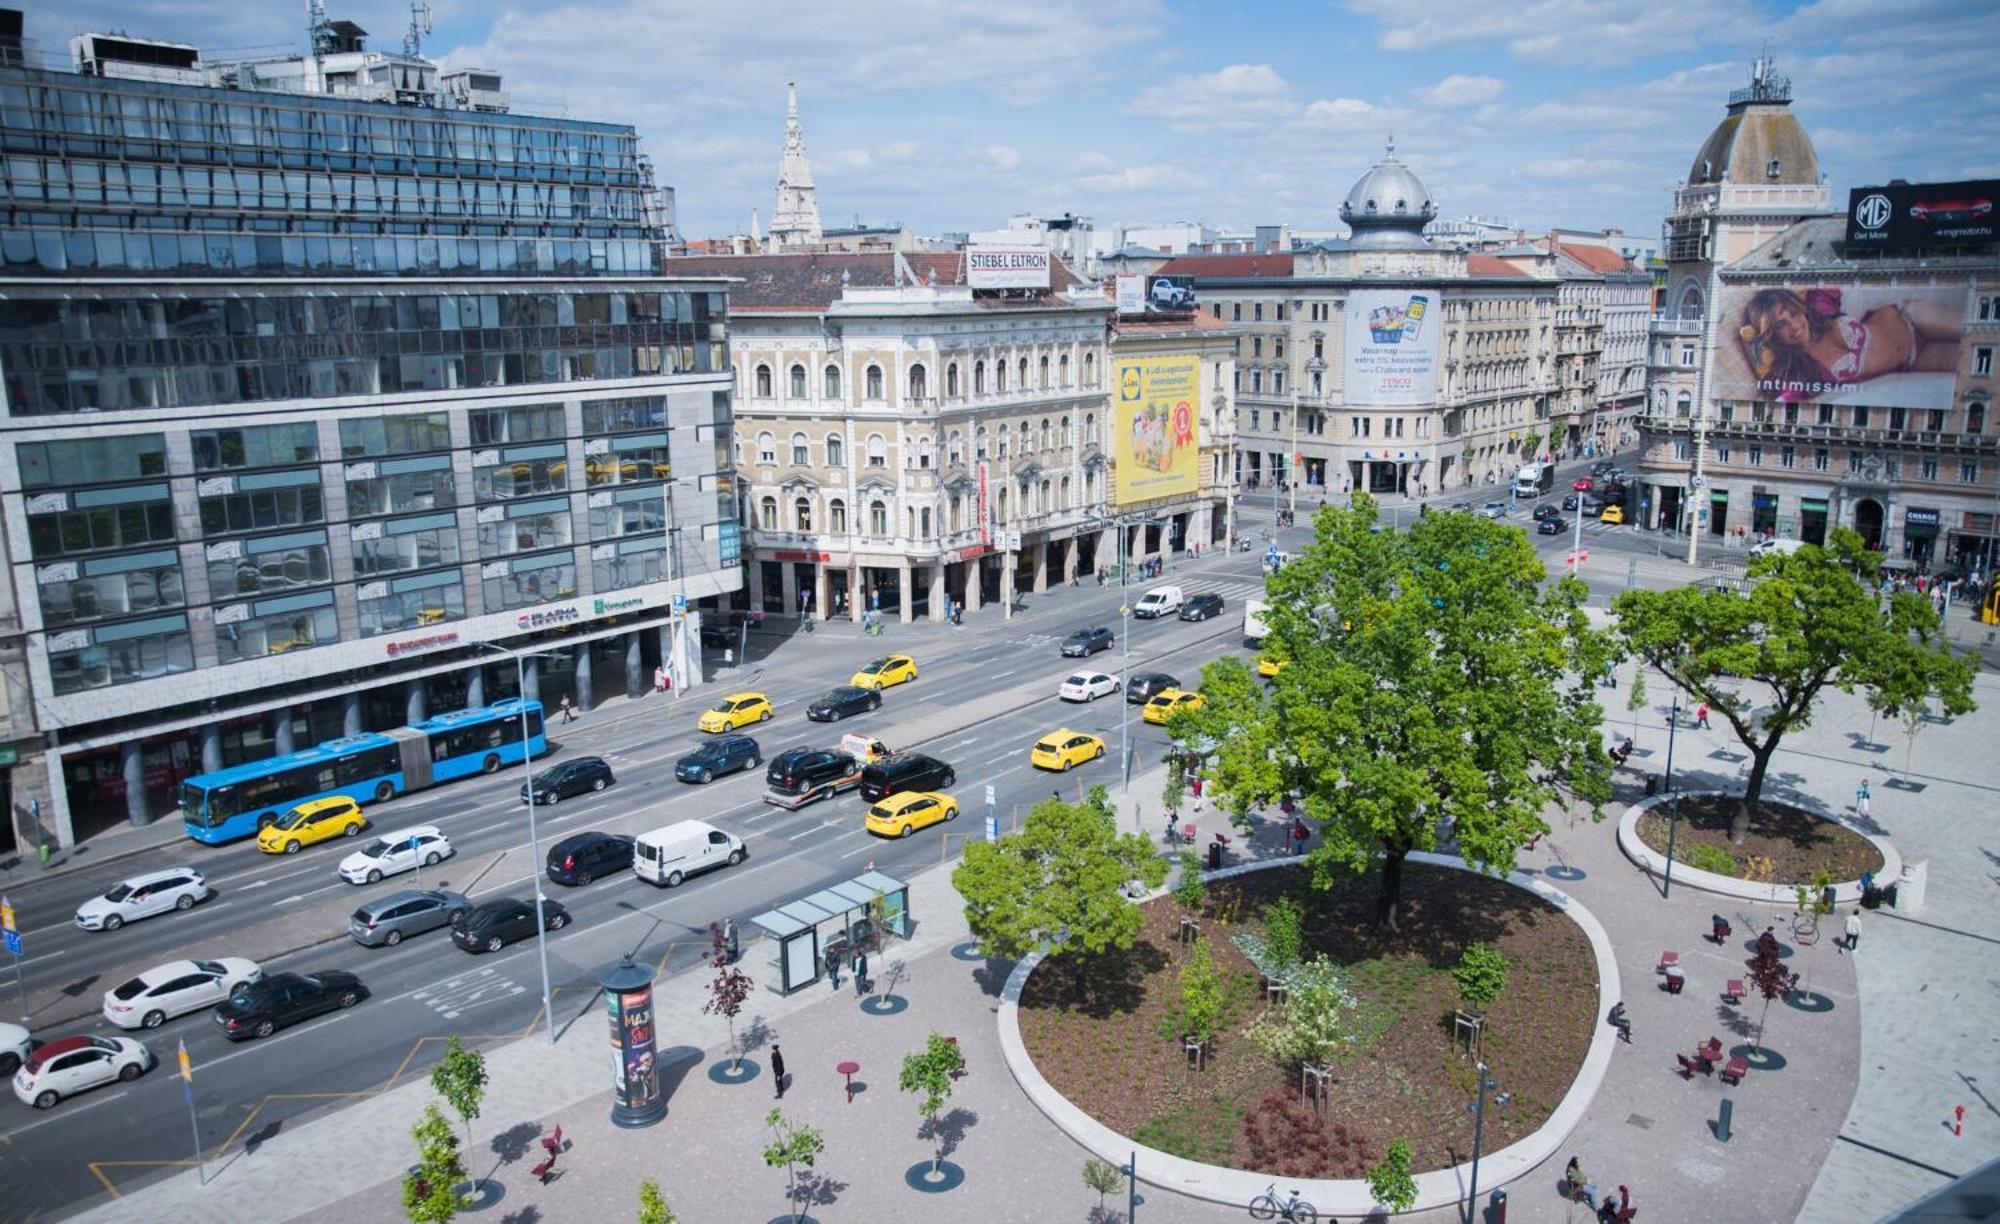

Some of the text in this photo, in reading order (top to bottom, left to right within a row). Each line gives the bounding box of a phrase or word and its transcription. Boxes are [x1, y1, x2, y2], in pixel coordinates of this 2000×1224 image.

[1859, 196, 1889, 227] MG
[971, 254, 1047, 268] STIEBEL ELTRON
[1756, 379, 1864, 393] intimissimi
[1907, 511, 1937, 521] CHANGE
